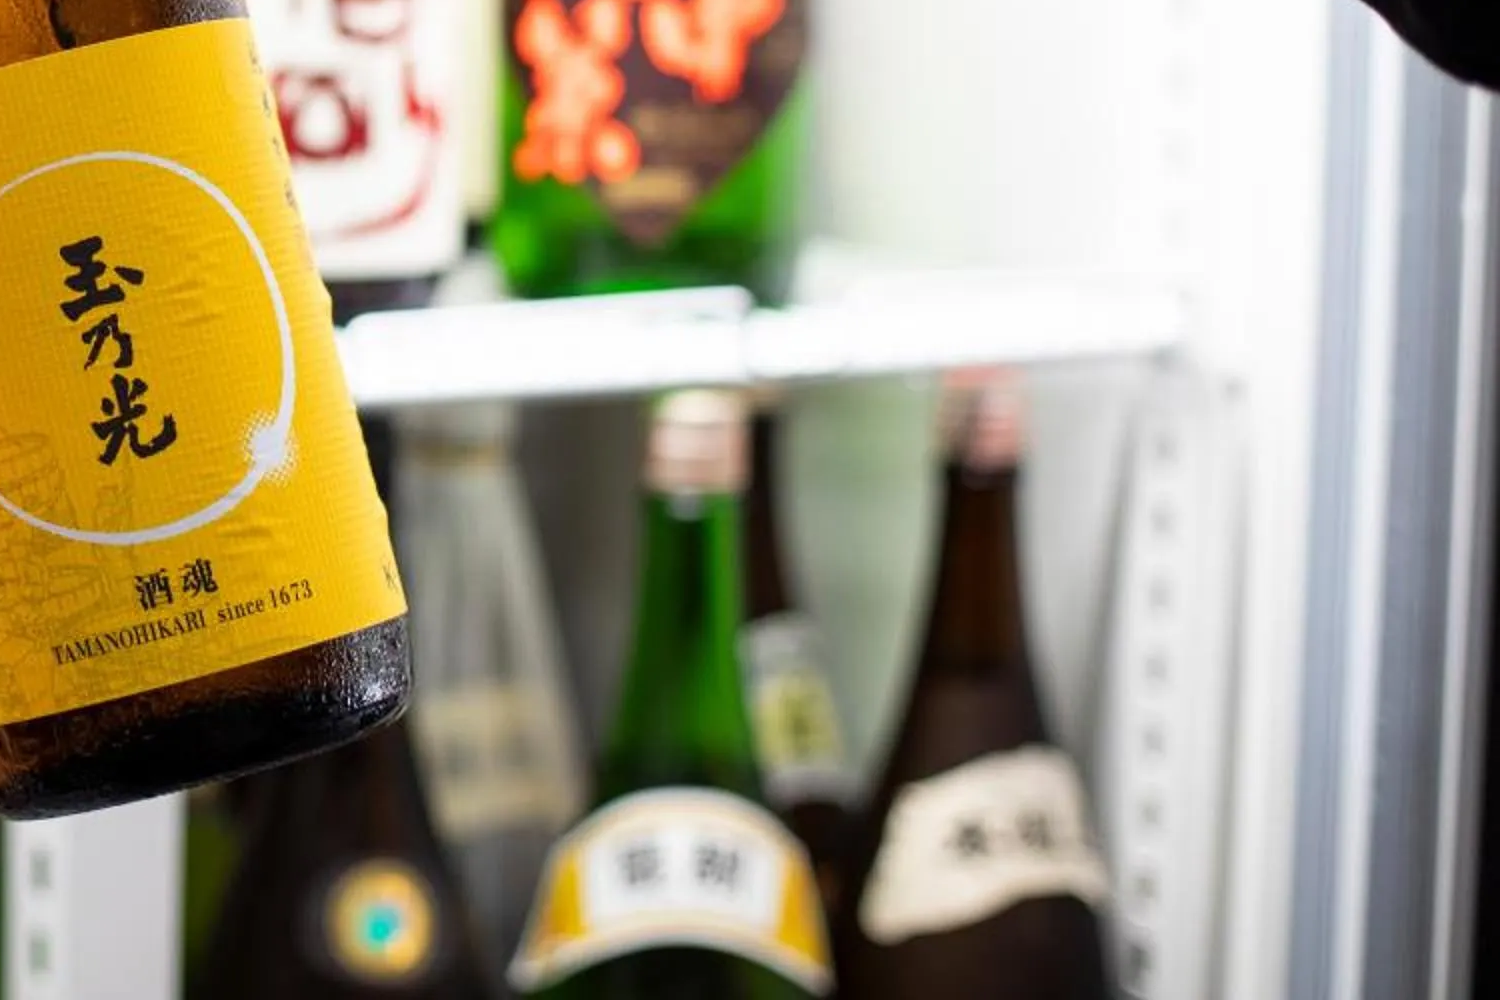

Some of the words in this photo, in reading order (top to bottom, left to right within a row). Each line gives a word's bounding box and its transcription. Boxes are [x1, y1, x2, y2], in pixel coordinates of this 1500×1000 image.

[59, 235, 177, 466] 玉乃光
[52, 608, 207, 666] TAMANOHIKARI
[216, 597, 266, 625] since
[269, 578, 315, 609] 1673
[135, 558, 219, 610] 酒魂
